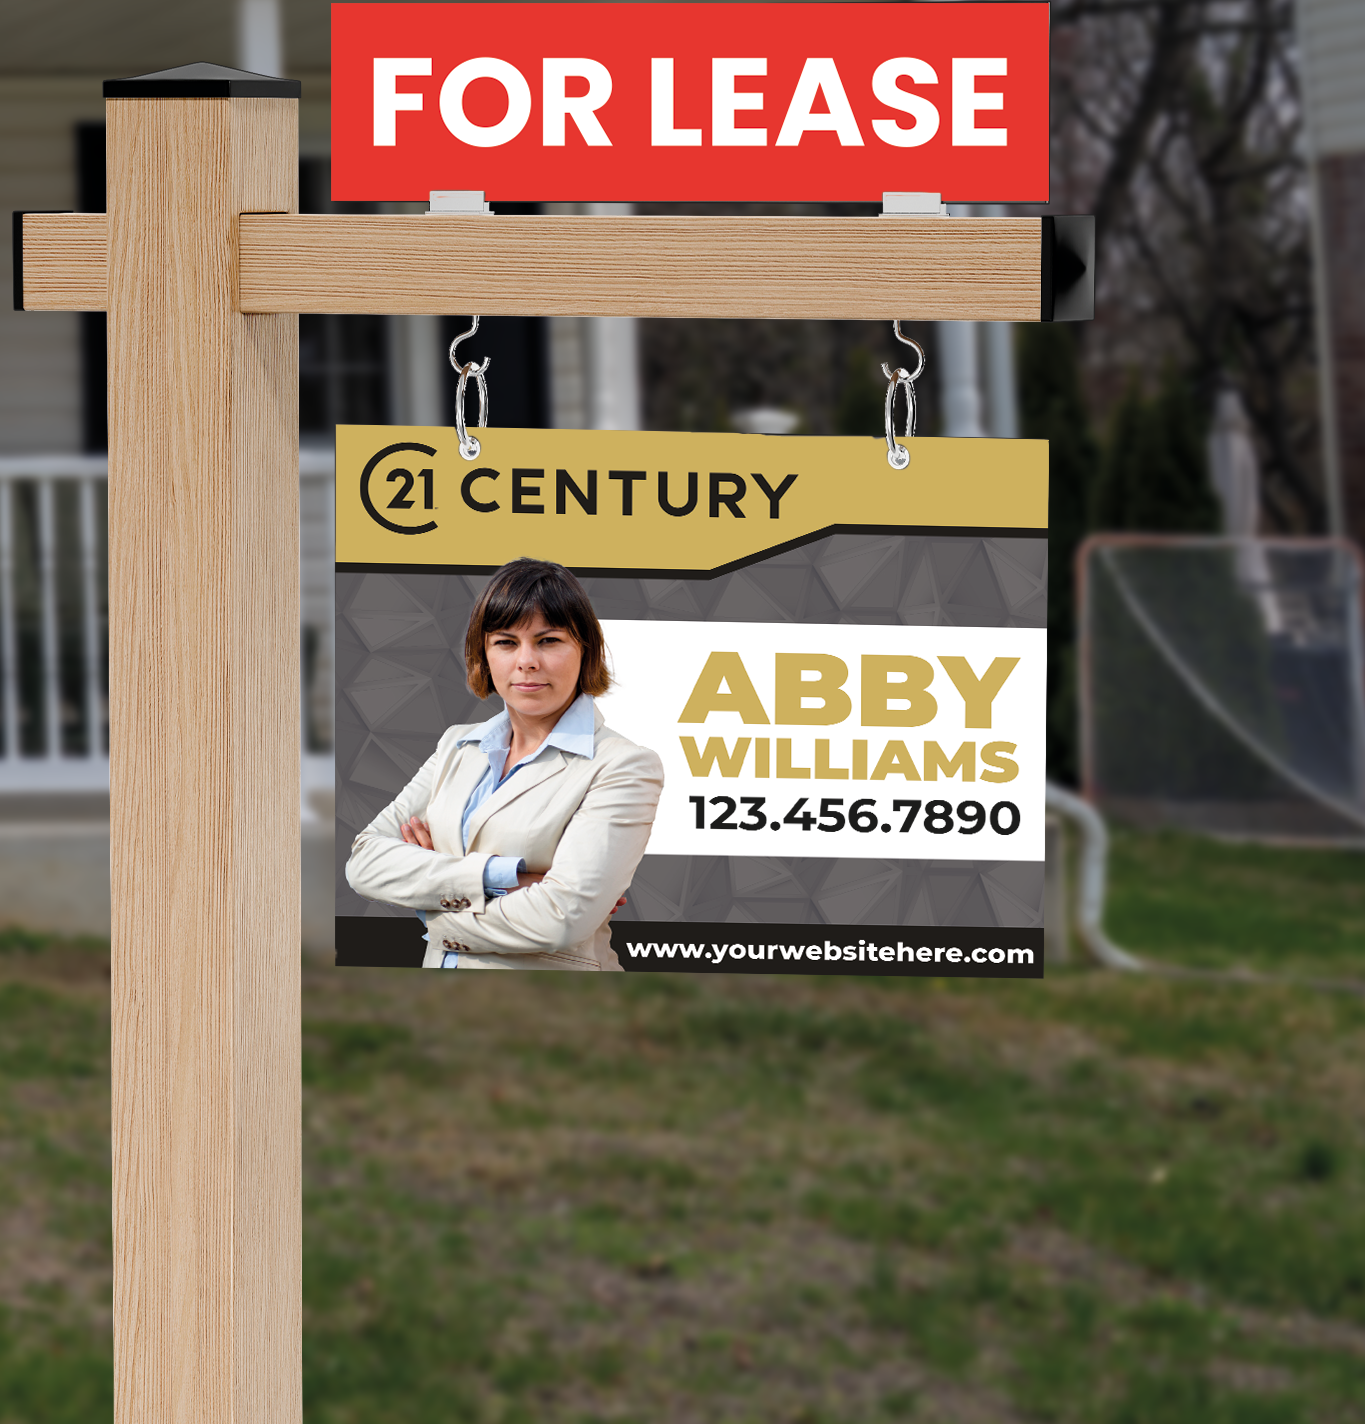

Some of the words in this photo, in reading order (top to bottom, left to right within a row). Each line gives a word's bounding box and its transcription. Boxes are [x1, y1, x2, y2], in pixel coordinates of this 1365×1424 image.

[374, 57, 612, 147] FOR
[651, 57, 1008, 147] LEASE
[460, 467, 799, 519] CENTURY
[677, 651, 1021, 729] ABBY
[678, 735, 1020, 784] WILLIAMS
[689, 795, 1021, 836] 123.456.7890
[626, 939, 1034, 965] www.yourwebsitehere.com
